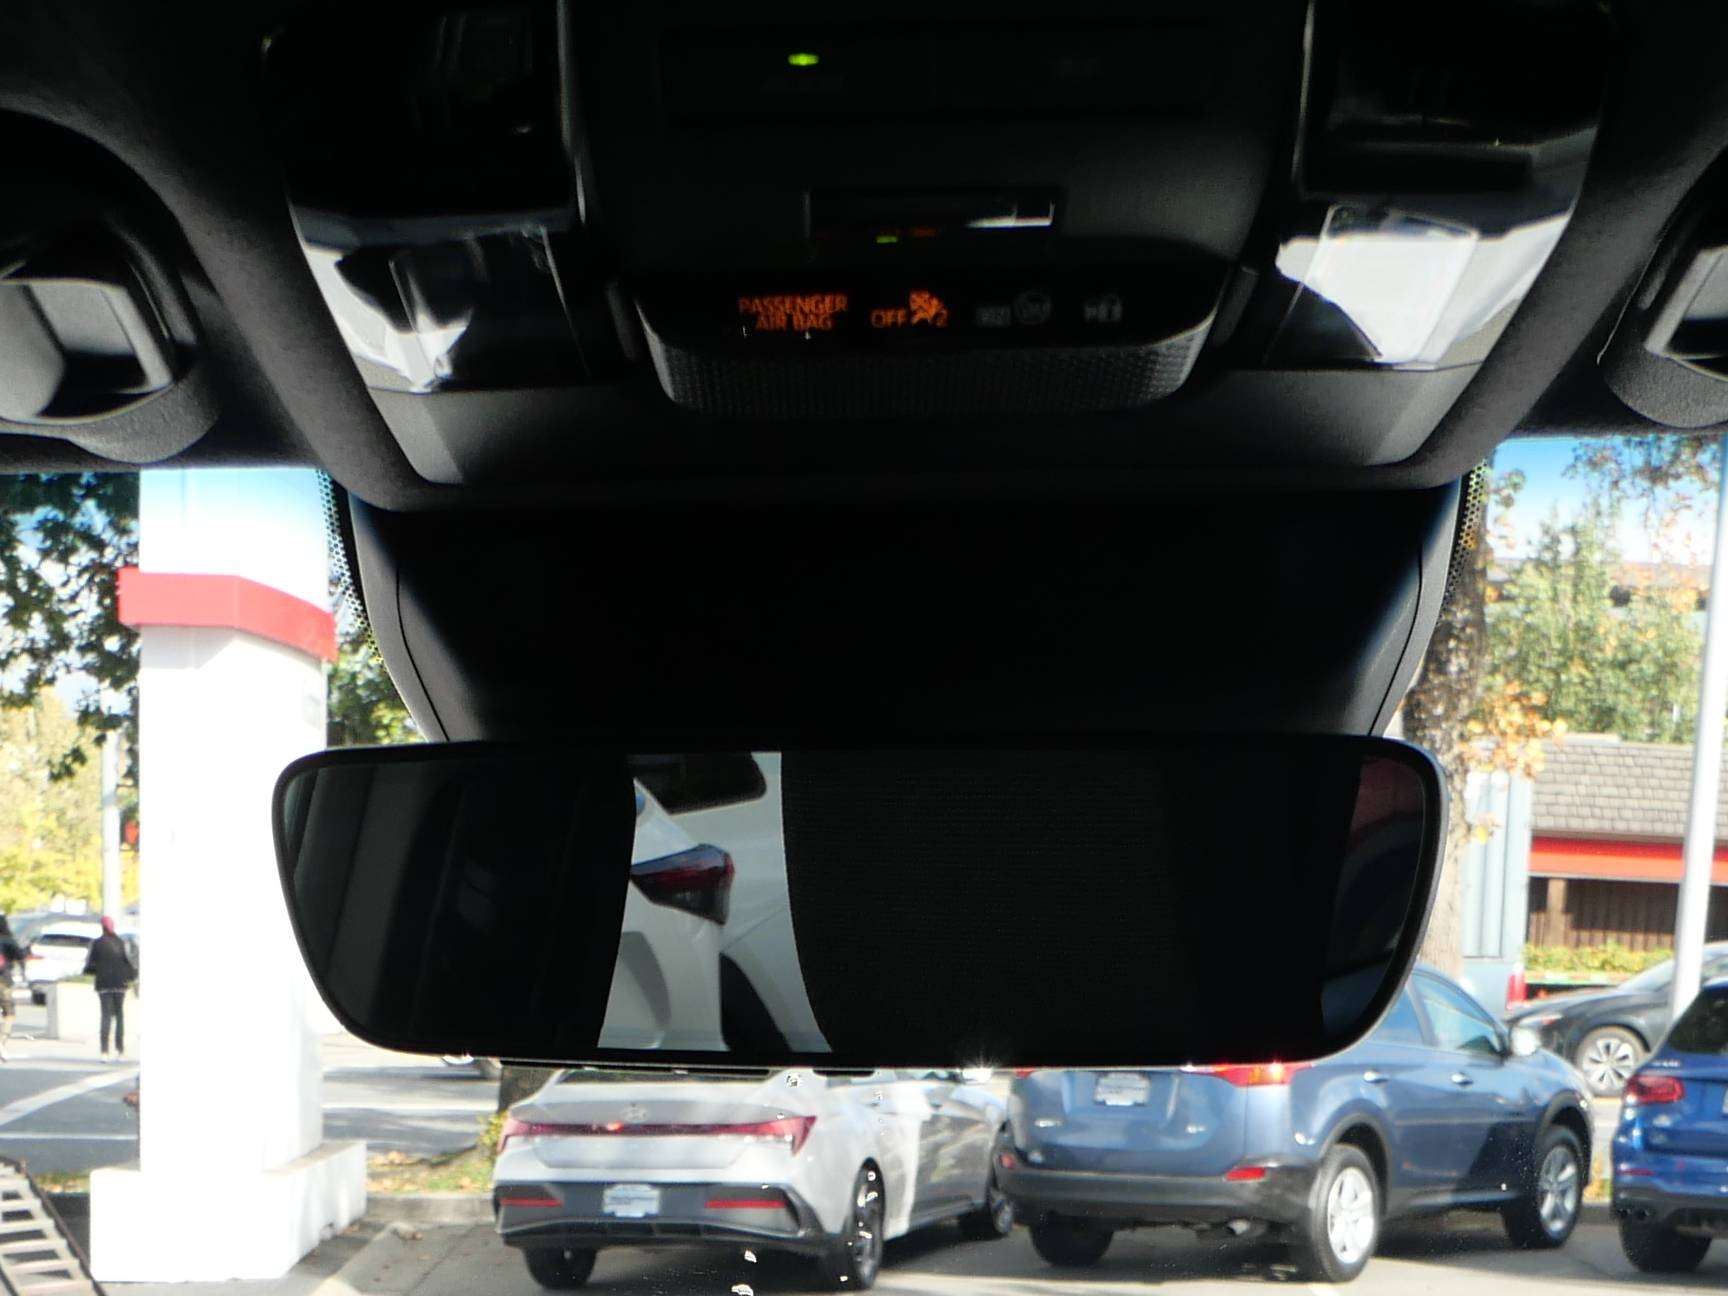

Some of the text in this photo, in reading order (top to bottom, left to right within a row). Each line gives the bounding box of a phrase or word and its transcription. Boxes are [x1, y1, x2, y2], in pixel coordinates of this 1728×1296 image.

[739, 294, 849, 313] PASSENGER
[756, 312, 832, 330] AIR BAG
[872, 308, 907, 328] OFF
